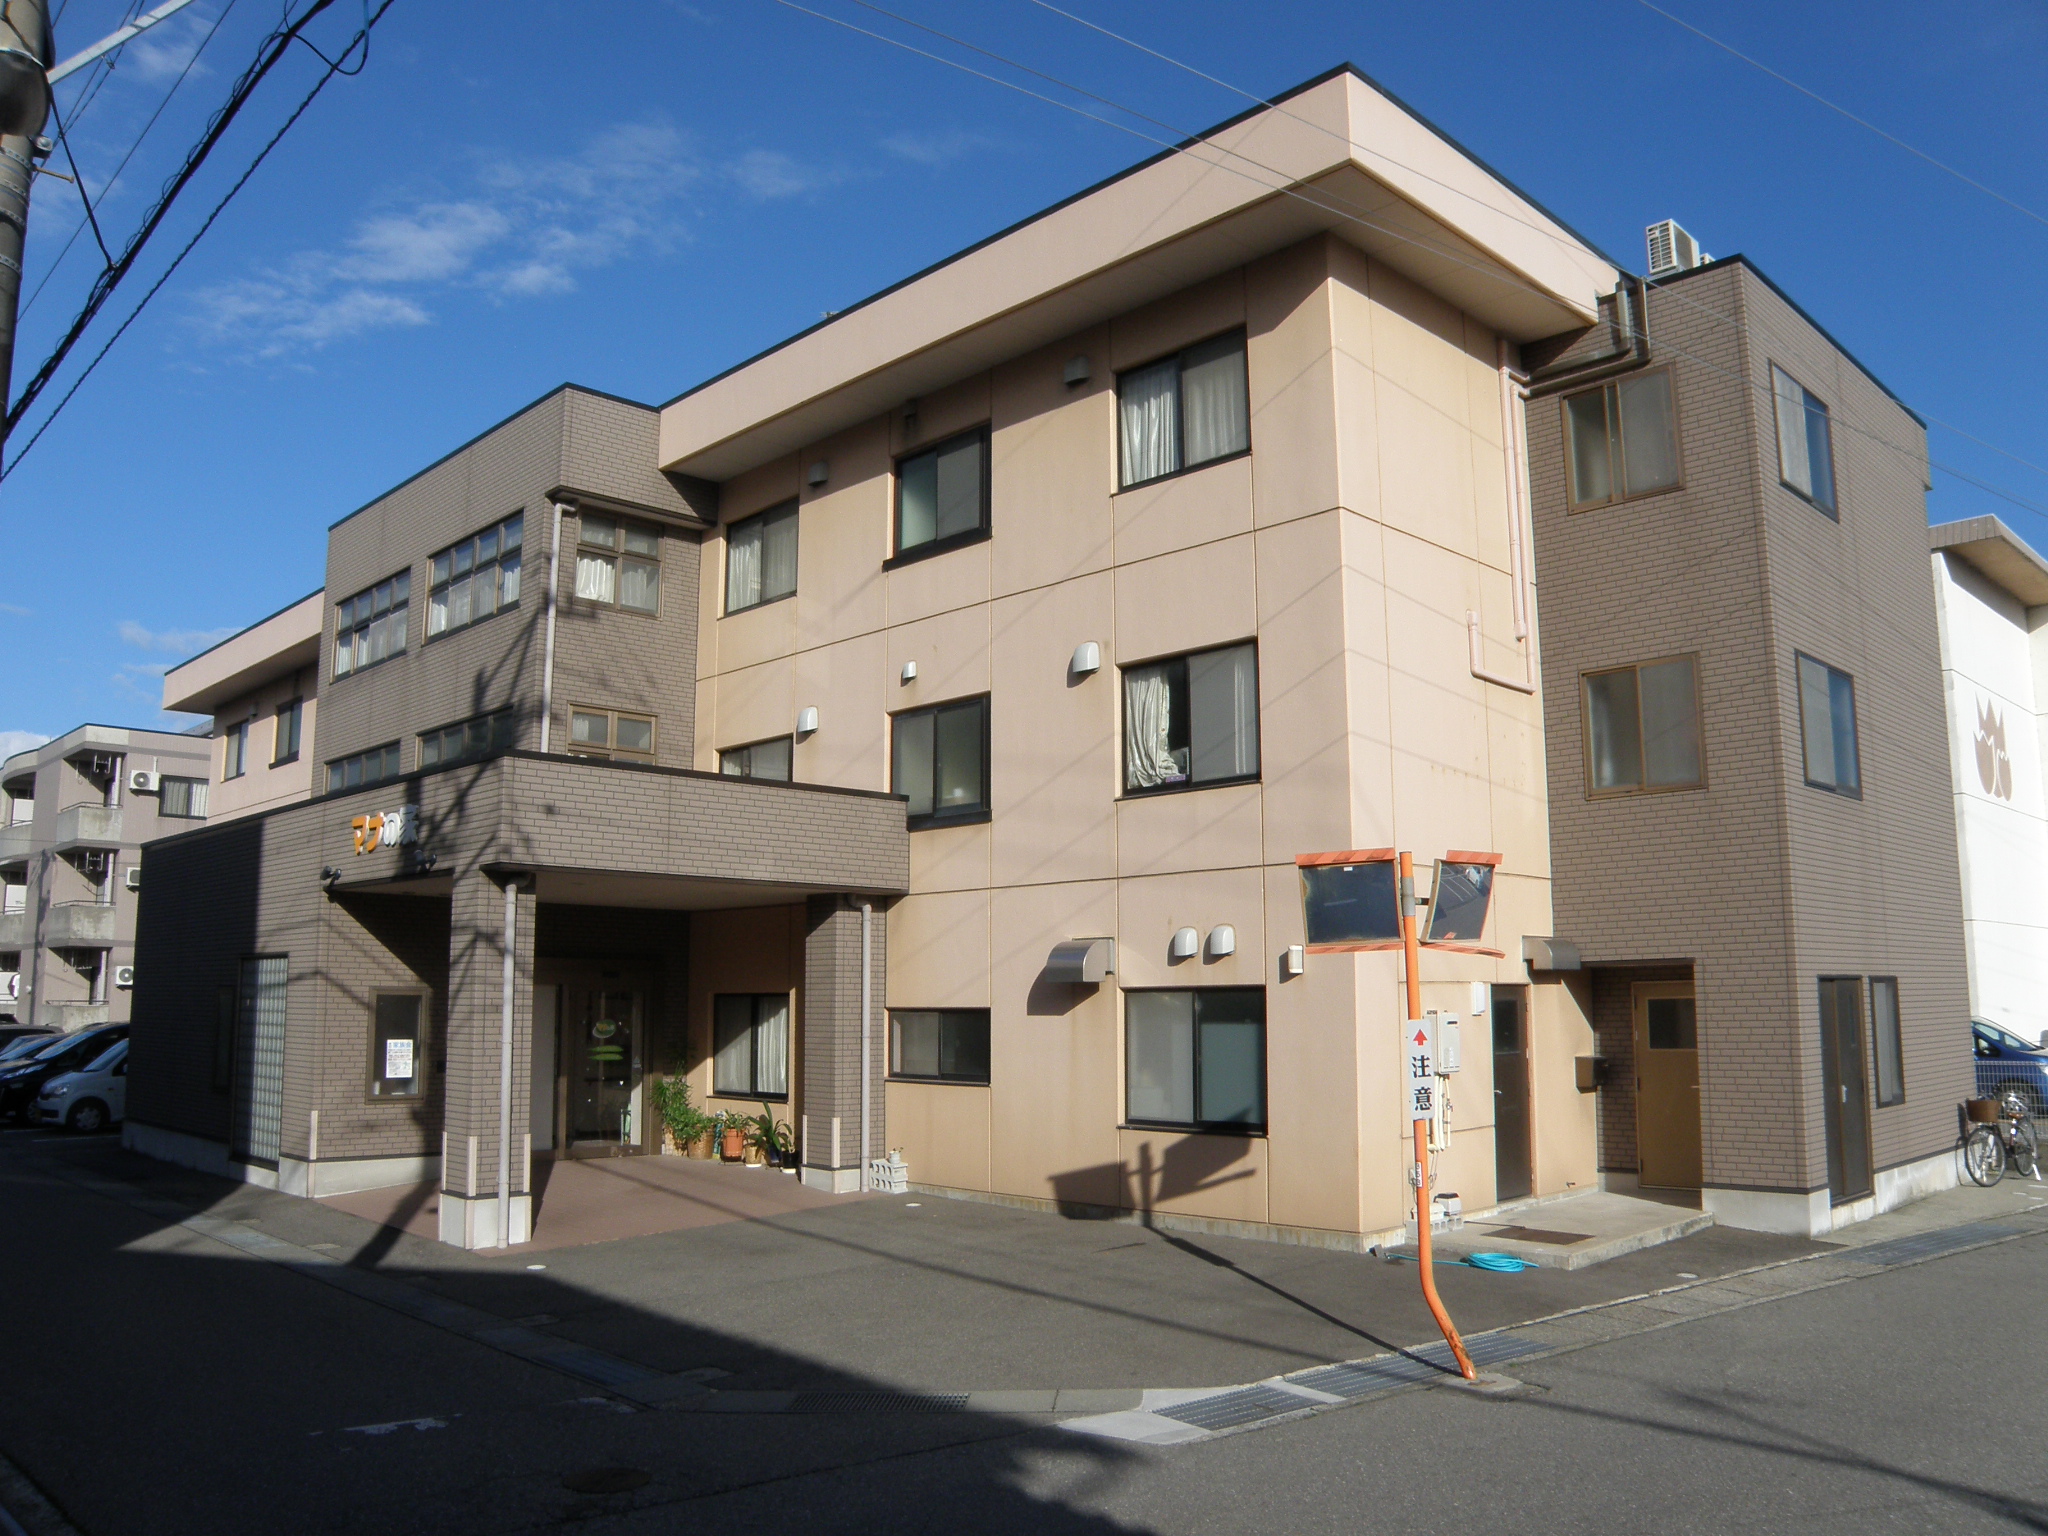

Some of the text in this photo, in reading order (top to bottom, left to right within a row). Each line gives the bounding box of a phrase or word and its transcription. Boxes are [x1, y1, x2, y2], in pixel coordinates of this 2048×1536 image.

[352, 804, 418, 855] マナの家
[1412, 1055, 1433, 1111] 注意
